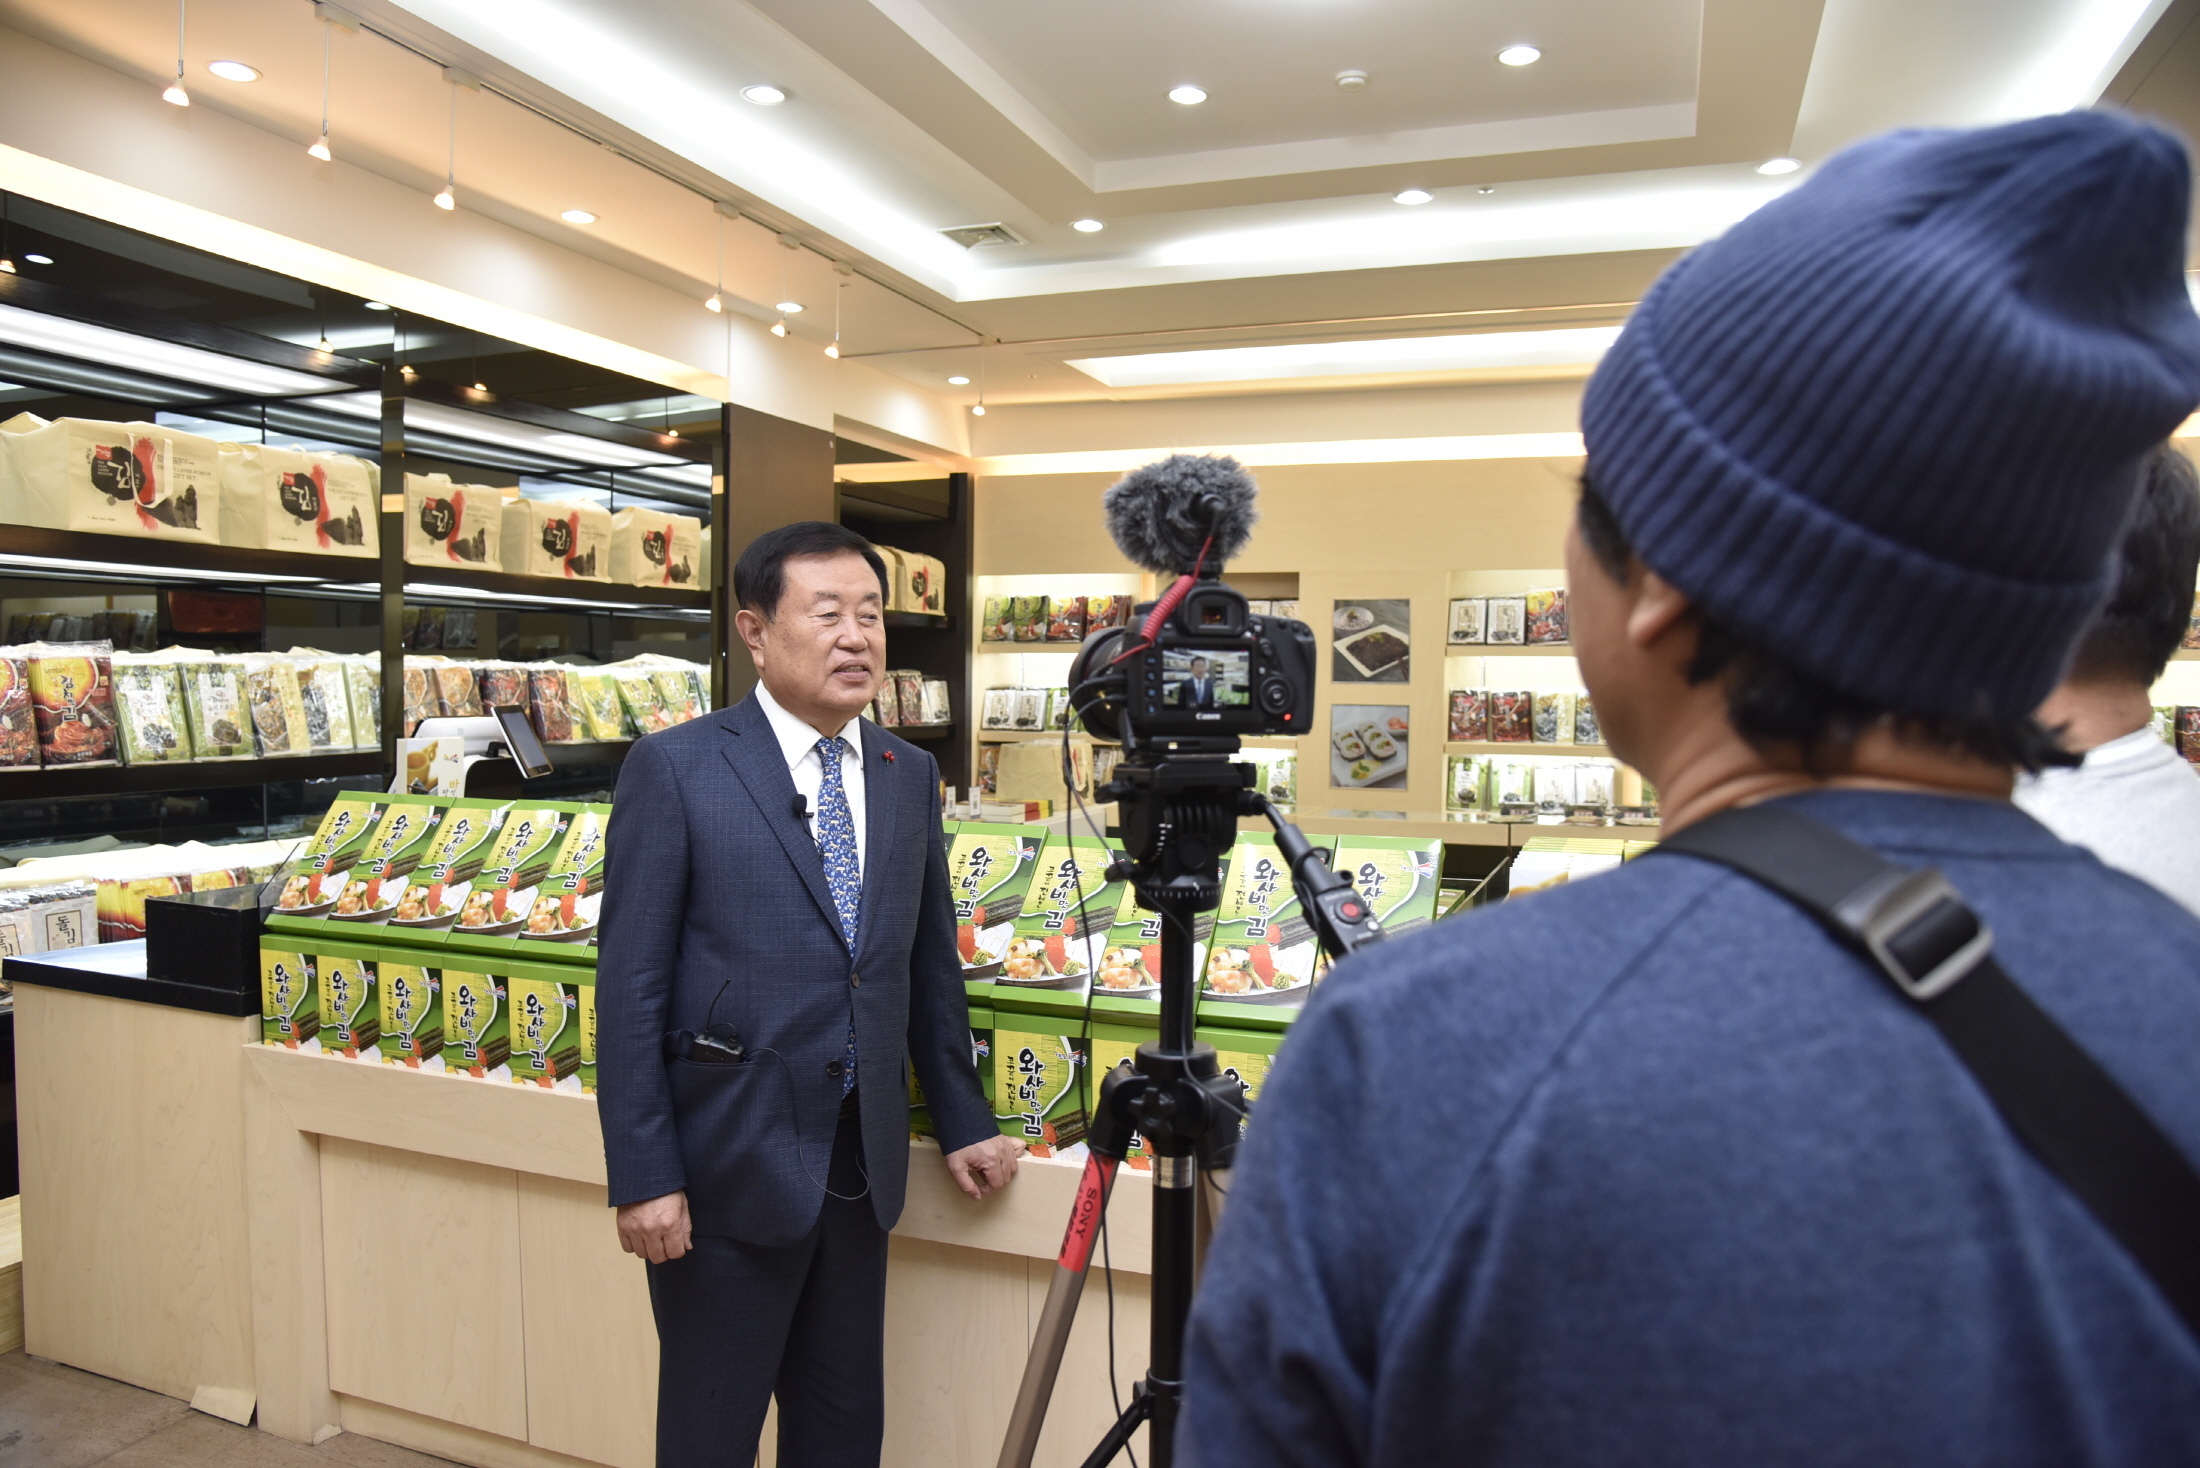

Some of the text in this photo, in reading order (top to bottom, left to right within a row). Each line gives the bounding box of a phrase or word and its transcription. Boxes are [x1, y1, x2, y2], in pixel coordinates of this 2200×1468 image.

[107, 461, 131, 489] 김
[291, 485, 312, 511] 김
[55, 915, 76, 944] 돌김
[1075, 1187, 1097, 1240] SONY
